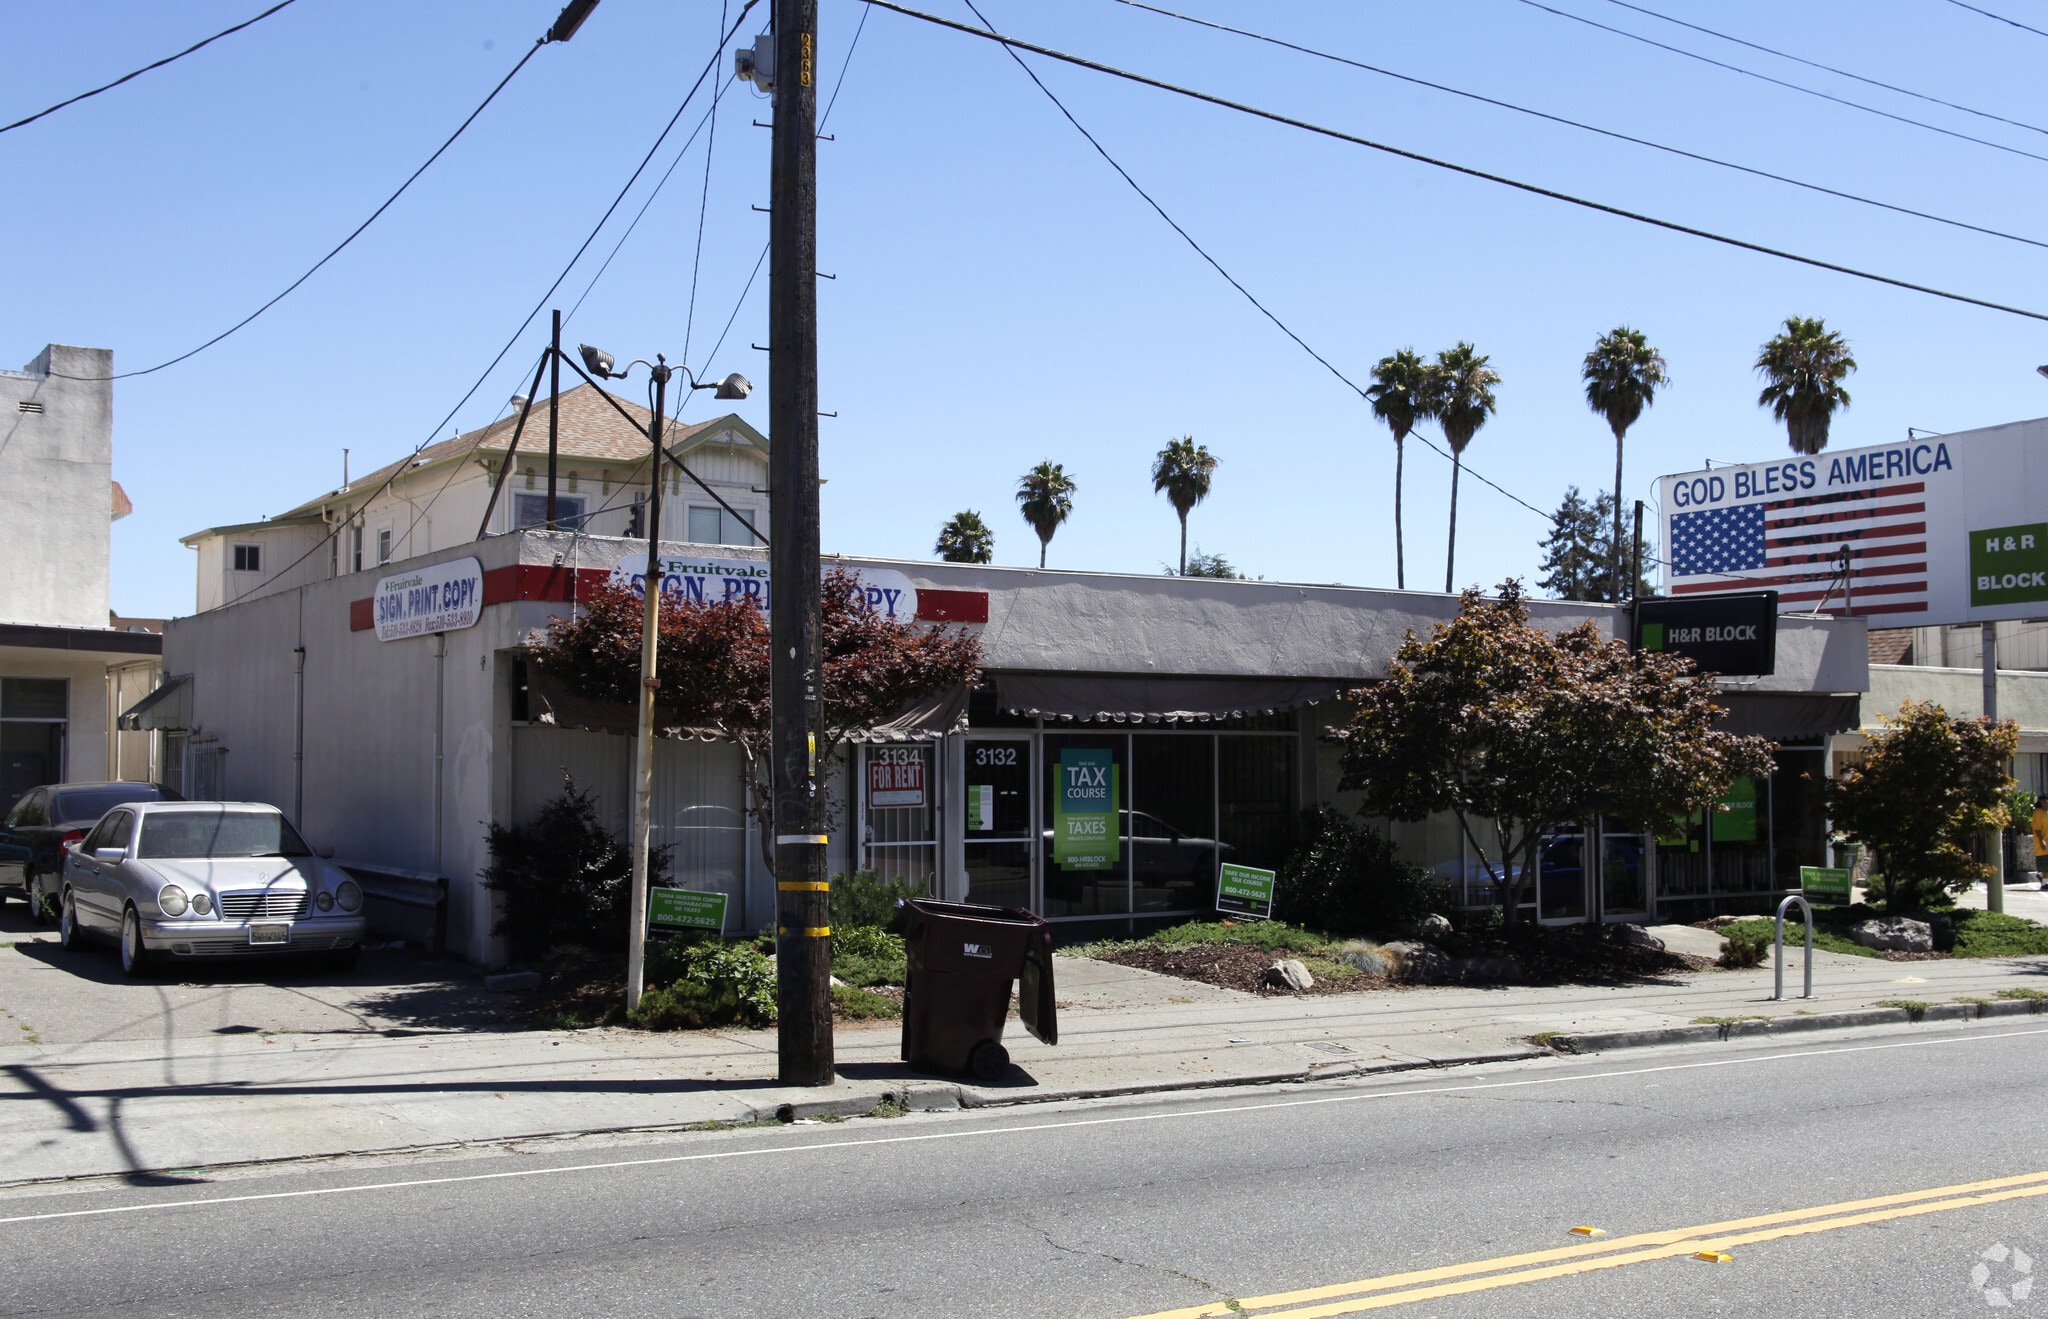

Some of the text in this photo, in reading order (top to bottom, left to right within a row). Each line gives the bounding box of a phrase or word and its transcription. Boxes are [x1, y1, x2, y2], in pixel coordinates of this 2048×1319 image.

[802, 34, 810, 86] 2363
[1673, 443, 1952, 508] GOD BLESS AMERICA
[1986, 537, 2000, 553] H
[2021, 534, 2035, 549] R
[667, 560, 768, 578] Fruitvale
[389, 575, 423, 592] Fruitvale
[1977, 571, 2046, 591] BLOCK
[1669, 625, 1757, 643] H&R BLOCK
[879, 749, 920, 765] 3134
[976, 748, 1017, 766] 3132
[873, 765, 921, 788] FOR RENT
[1066, 766, 1106, 786] TAX
[1067, 788, 1106, 799] COURSE
[1067, 821, 1106, 834] TAXES
[675, 894, 702, 902] NUESTRO
[656, 913, 716, 926] 800-472-5625
